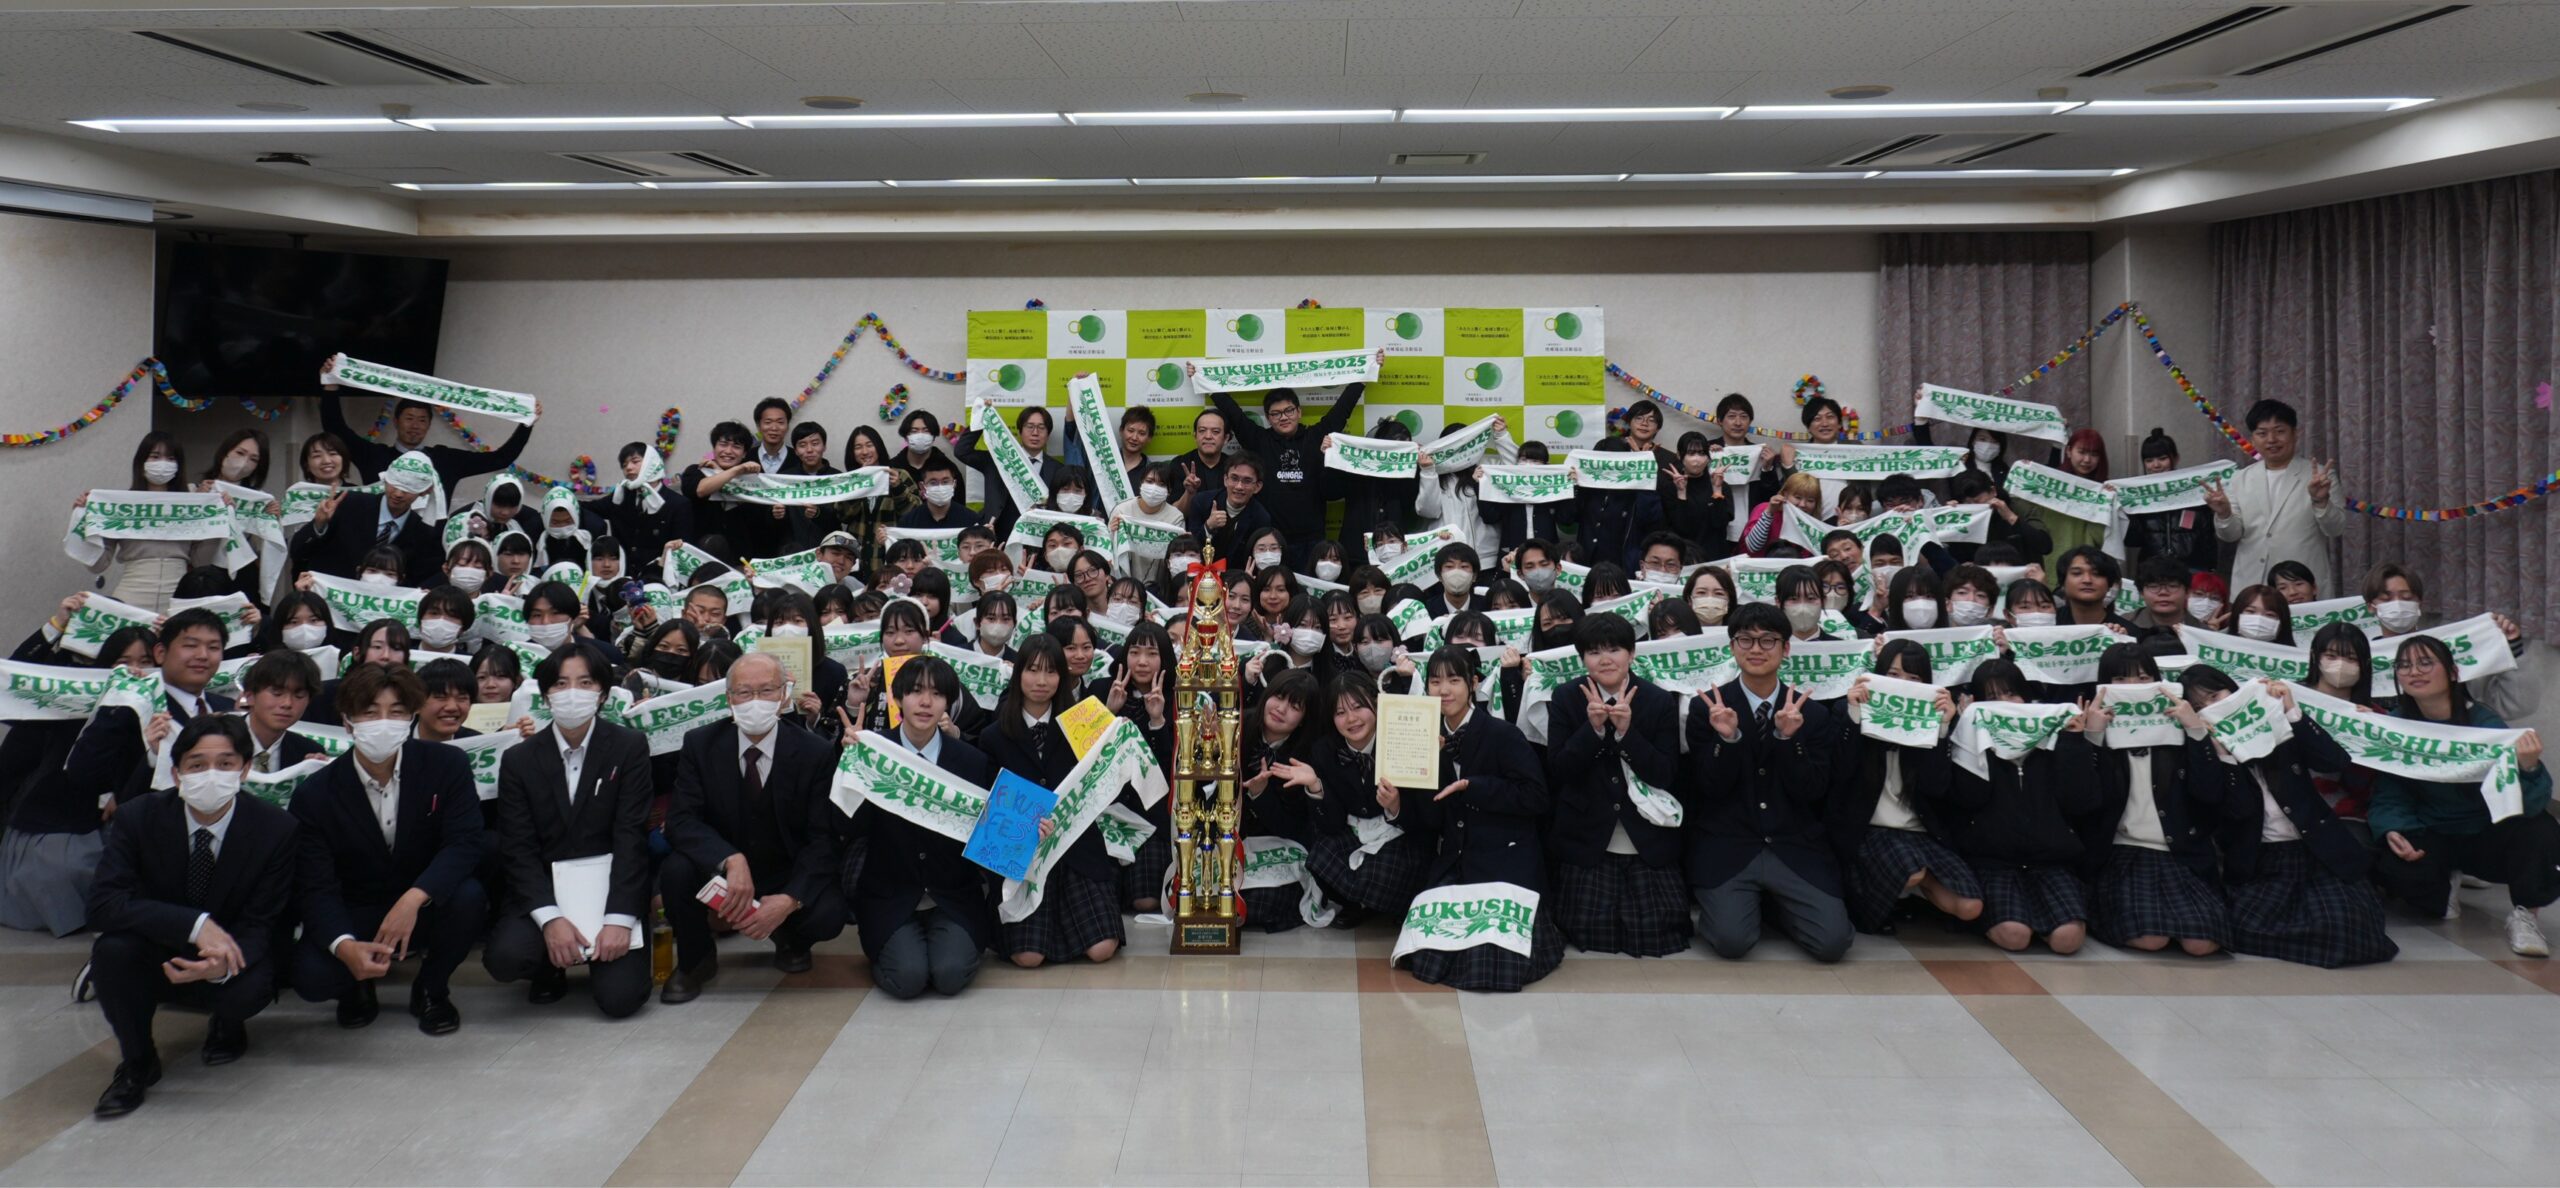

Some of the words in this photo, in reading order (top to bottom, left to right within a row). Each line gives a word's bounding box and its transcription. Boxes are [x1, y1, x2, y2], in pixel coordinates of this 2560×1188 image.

[1202, 362, 1283, 377] FUKUSHI
[1286, 355, 1367, 373] FES-2025
[1931, 390, 2017, 416] FUKUSHI
[1340, 444, 1418, 463] FUKUSHI
[1579, 458, 1657, 472] FUKUSHI
[326, 587, 418, 615] FUKUS
[8, 673, 107, 696] FUKU
[2297, 701, 2443, 755] FUKUSHI
